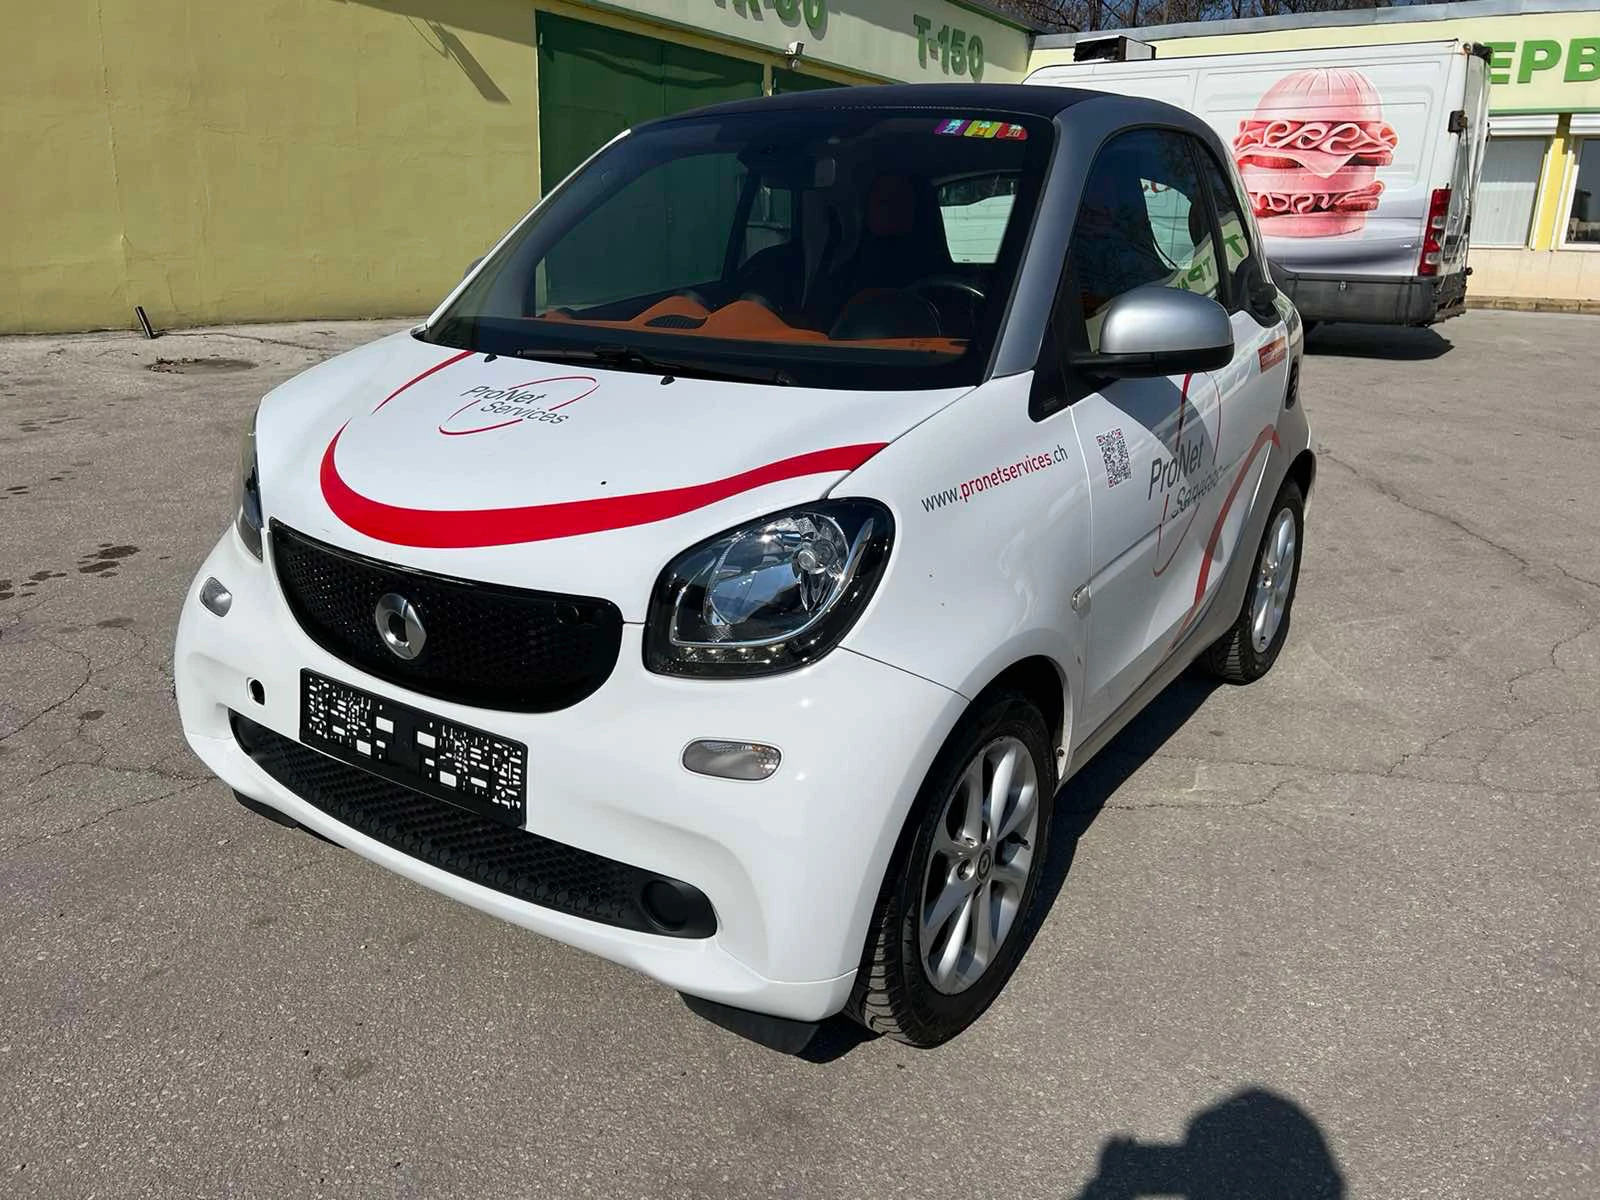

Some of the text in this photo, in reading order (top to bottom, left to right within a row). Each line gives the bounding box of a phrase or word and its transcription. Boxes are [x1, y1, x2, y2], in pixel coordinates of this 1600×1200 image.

[460, 385, 548, 405] ProNet
[480, 401, 569, 425] Services
[921, 443, 1069, 513] www.pronetservices.ch
[1147, 434, 1205, 501] ProNet
